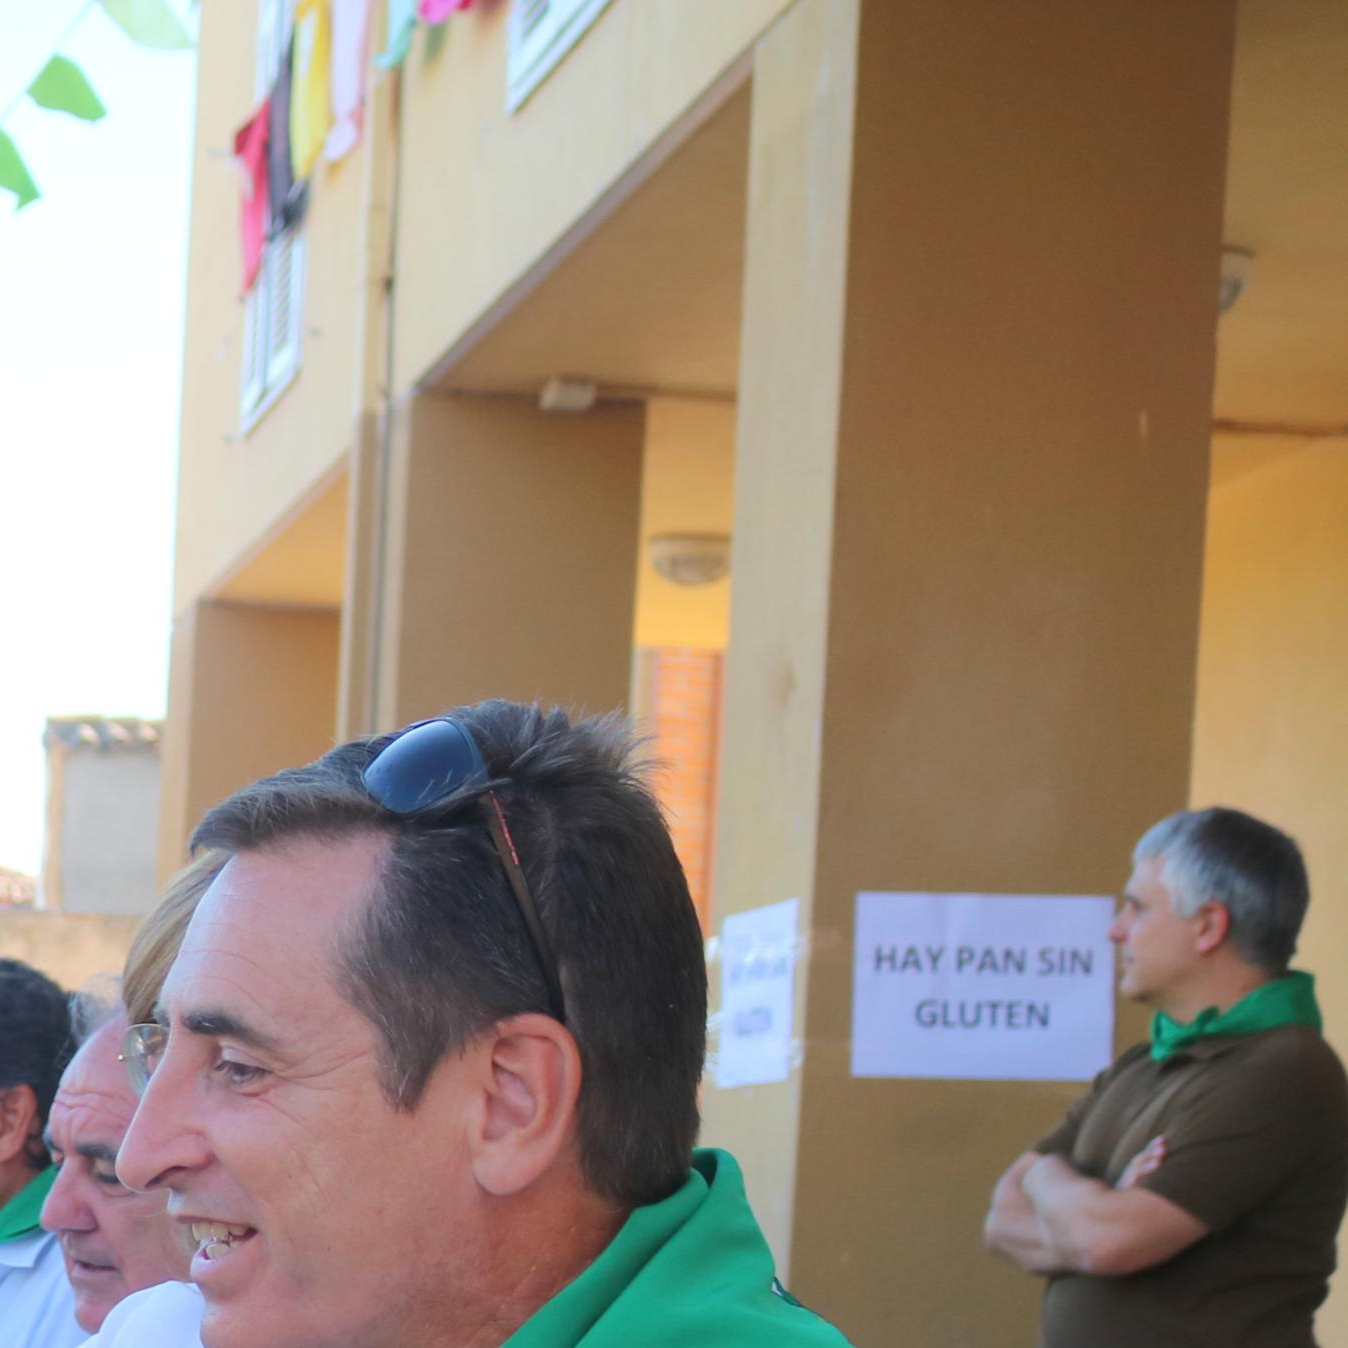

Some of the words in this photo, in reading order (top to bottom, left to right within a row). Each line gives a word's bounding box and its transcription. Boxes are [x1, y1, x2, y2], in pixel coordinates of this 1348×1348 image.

[873, 944, 943, 973] HAY
[956, 946, 1027, 974] PAN
[1037, 947, 1094, 976] SIN
[914, 998, 1051, 1029] GLUTEN
